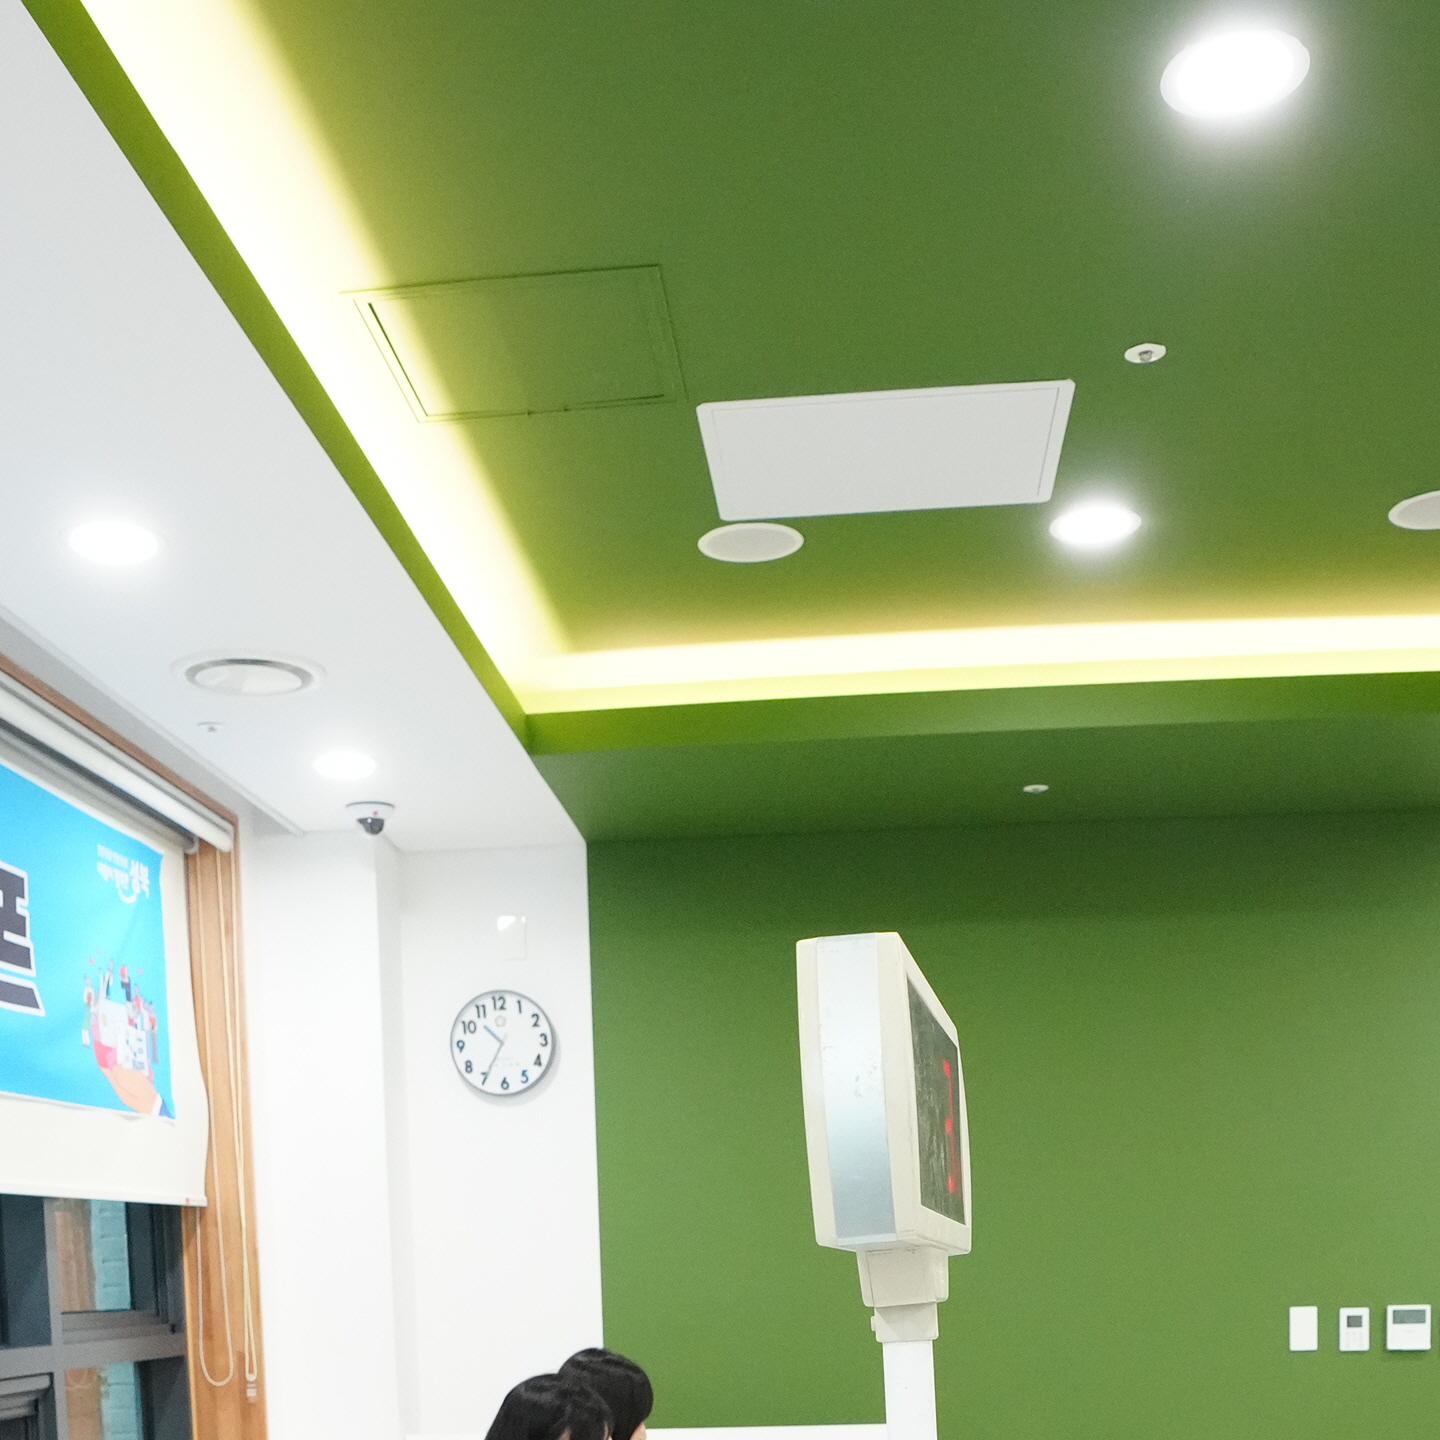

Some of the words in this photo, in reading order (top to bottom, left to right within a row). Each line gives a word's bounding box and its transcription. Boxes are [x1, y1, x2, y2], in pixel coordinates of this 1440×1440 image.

[492, 995, 506, 1011] 12
[516, 999, 523, 1014] 1
[475, 1004, 487, 1019] 11
[461, 1020, 477, 1035] 10
[531, 1013, 540, 1028] 2
[456, 1039, 466, 1053] 9
[540, 1032, 549, 1047] 3
[464, 1059, 474, 1074] 8
[533, 1053, 543, 1067] 4
[480, 1072, 490, 1086] 7
[500, 1077, 510, 1091] 6
[520, 1069, 530, 1084] 5
